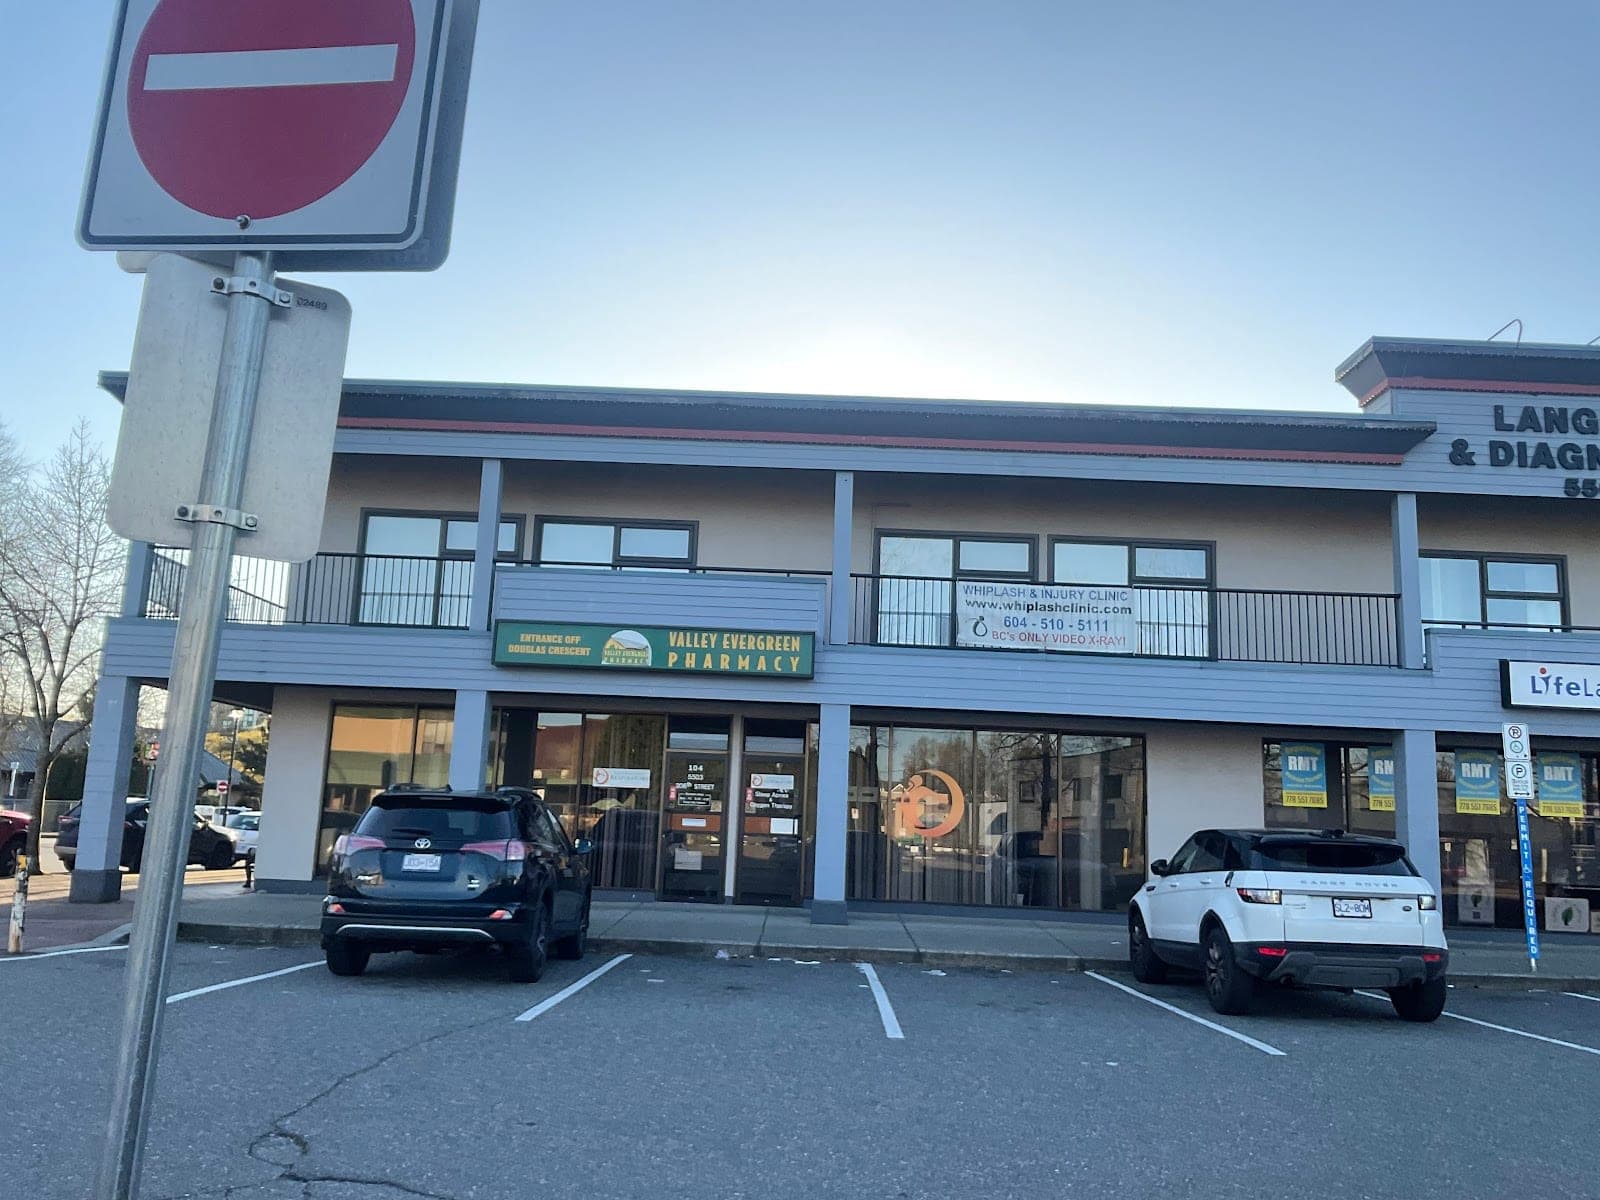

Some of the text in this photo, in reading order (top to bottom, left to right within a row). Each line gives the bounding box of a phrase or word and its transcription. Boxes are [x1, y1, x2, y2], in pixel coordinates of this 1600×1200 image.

[1494, 405, 1600, 435] LANG
[1449, 438, 1477, 466] &
[963, 585, 1128, 601] WHIPLASH & INJURY CLINIC
[965, 599, 1132, 615] www.whiplashclinic.com
[1003, 616, 1027, 629] 604
[1040, 618, 1064, 631] 510
[1078, 620, 1108, 632] 5111
[520, 634, 581, 645] ENTRANCE OFF
[669, 631, 800, 652] VALLEY EVERGREEN
[992, 631, 1126, 646] BC's ONLY VIDEO X-RAY!
[508, 644, 592, 656] DOUGLAS CRESCENT
[668, 651, 800, 672] PHARMACY
[1287, 755, 1319, 771] RMT
[1461, 762, 1492, 779] RMT
[1544, 765, 1574, 782] RMT
[1519, 806, 1529, 859] PERMIT
[1525, 880, 1538, 954] REQUIRED
